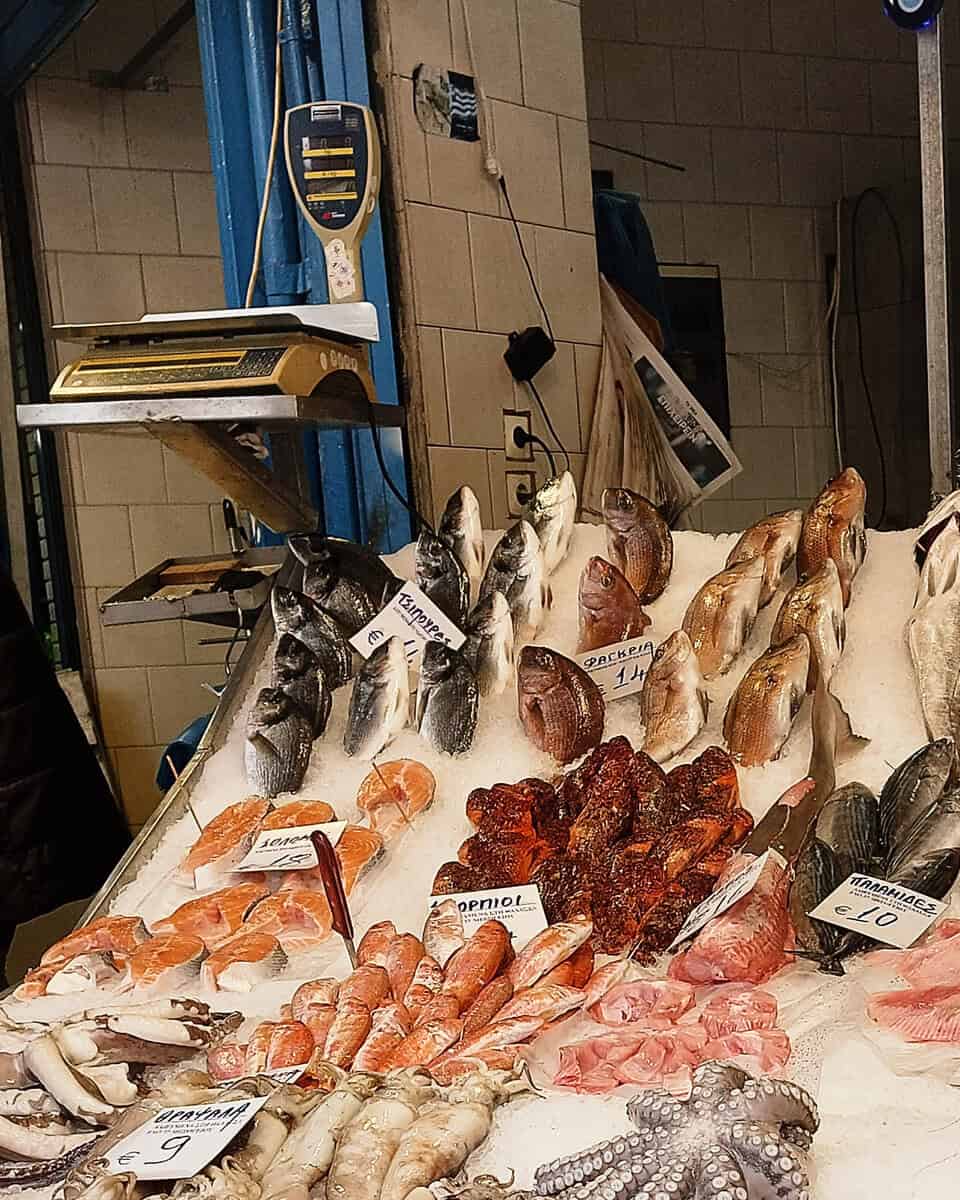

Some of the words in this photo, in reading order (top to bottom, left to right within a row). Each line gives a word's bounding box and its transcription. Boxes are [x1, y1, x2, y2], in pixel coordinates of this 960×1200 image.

[583, 641, 655, 670] ΦΑΓΚΡΙΑ
[613, 664, 649, 689] 14
[849, 876, 938, 916] ΠΑΛΑΜΙΔΕΣ
[834, 905, 852, 916] €
[846, 906, 899, 927] 10
[154, 1102, 251, 1132] ΘΡΑΨΑΛΑ
[117, 1151, 141, 1166] €
[144, 1135, 192, 1165] 9
